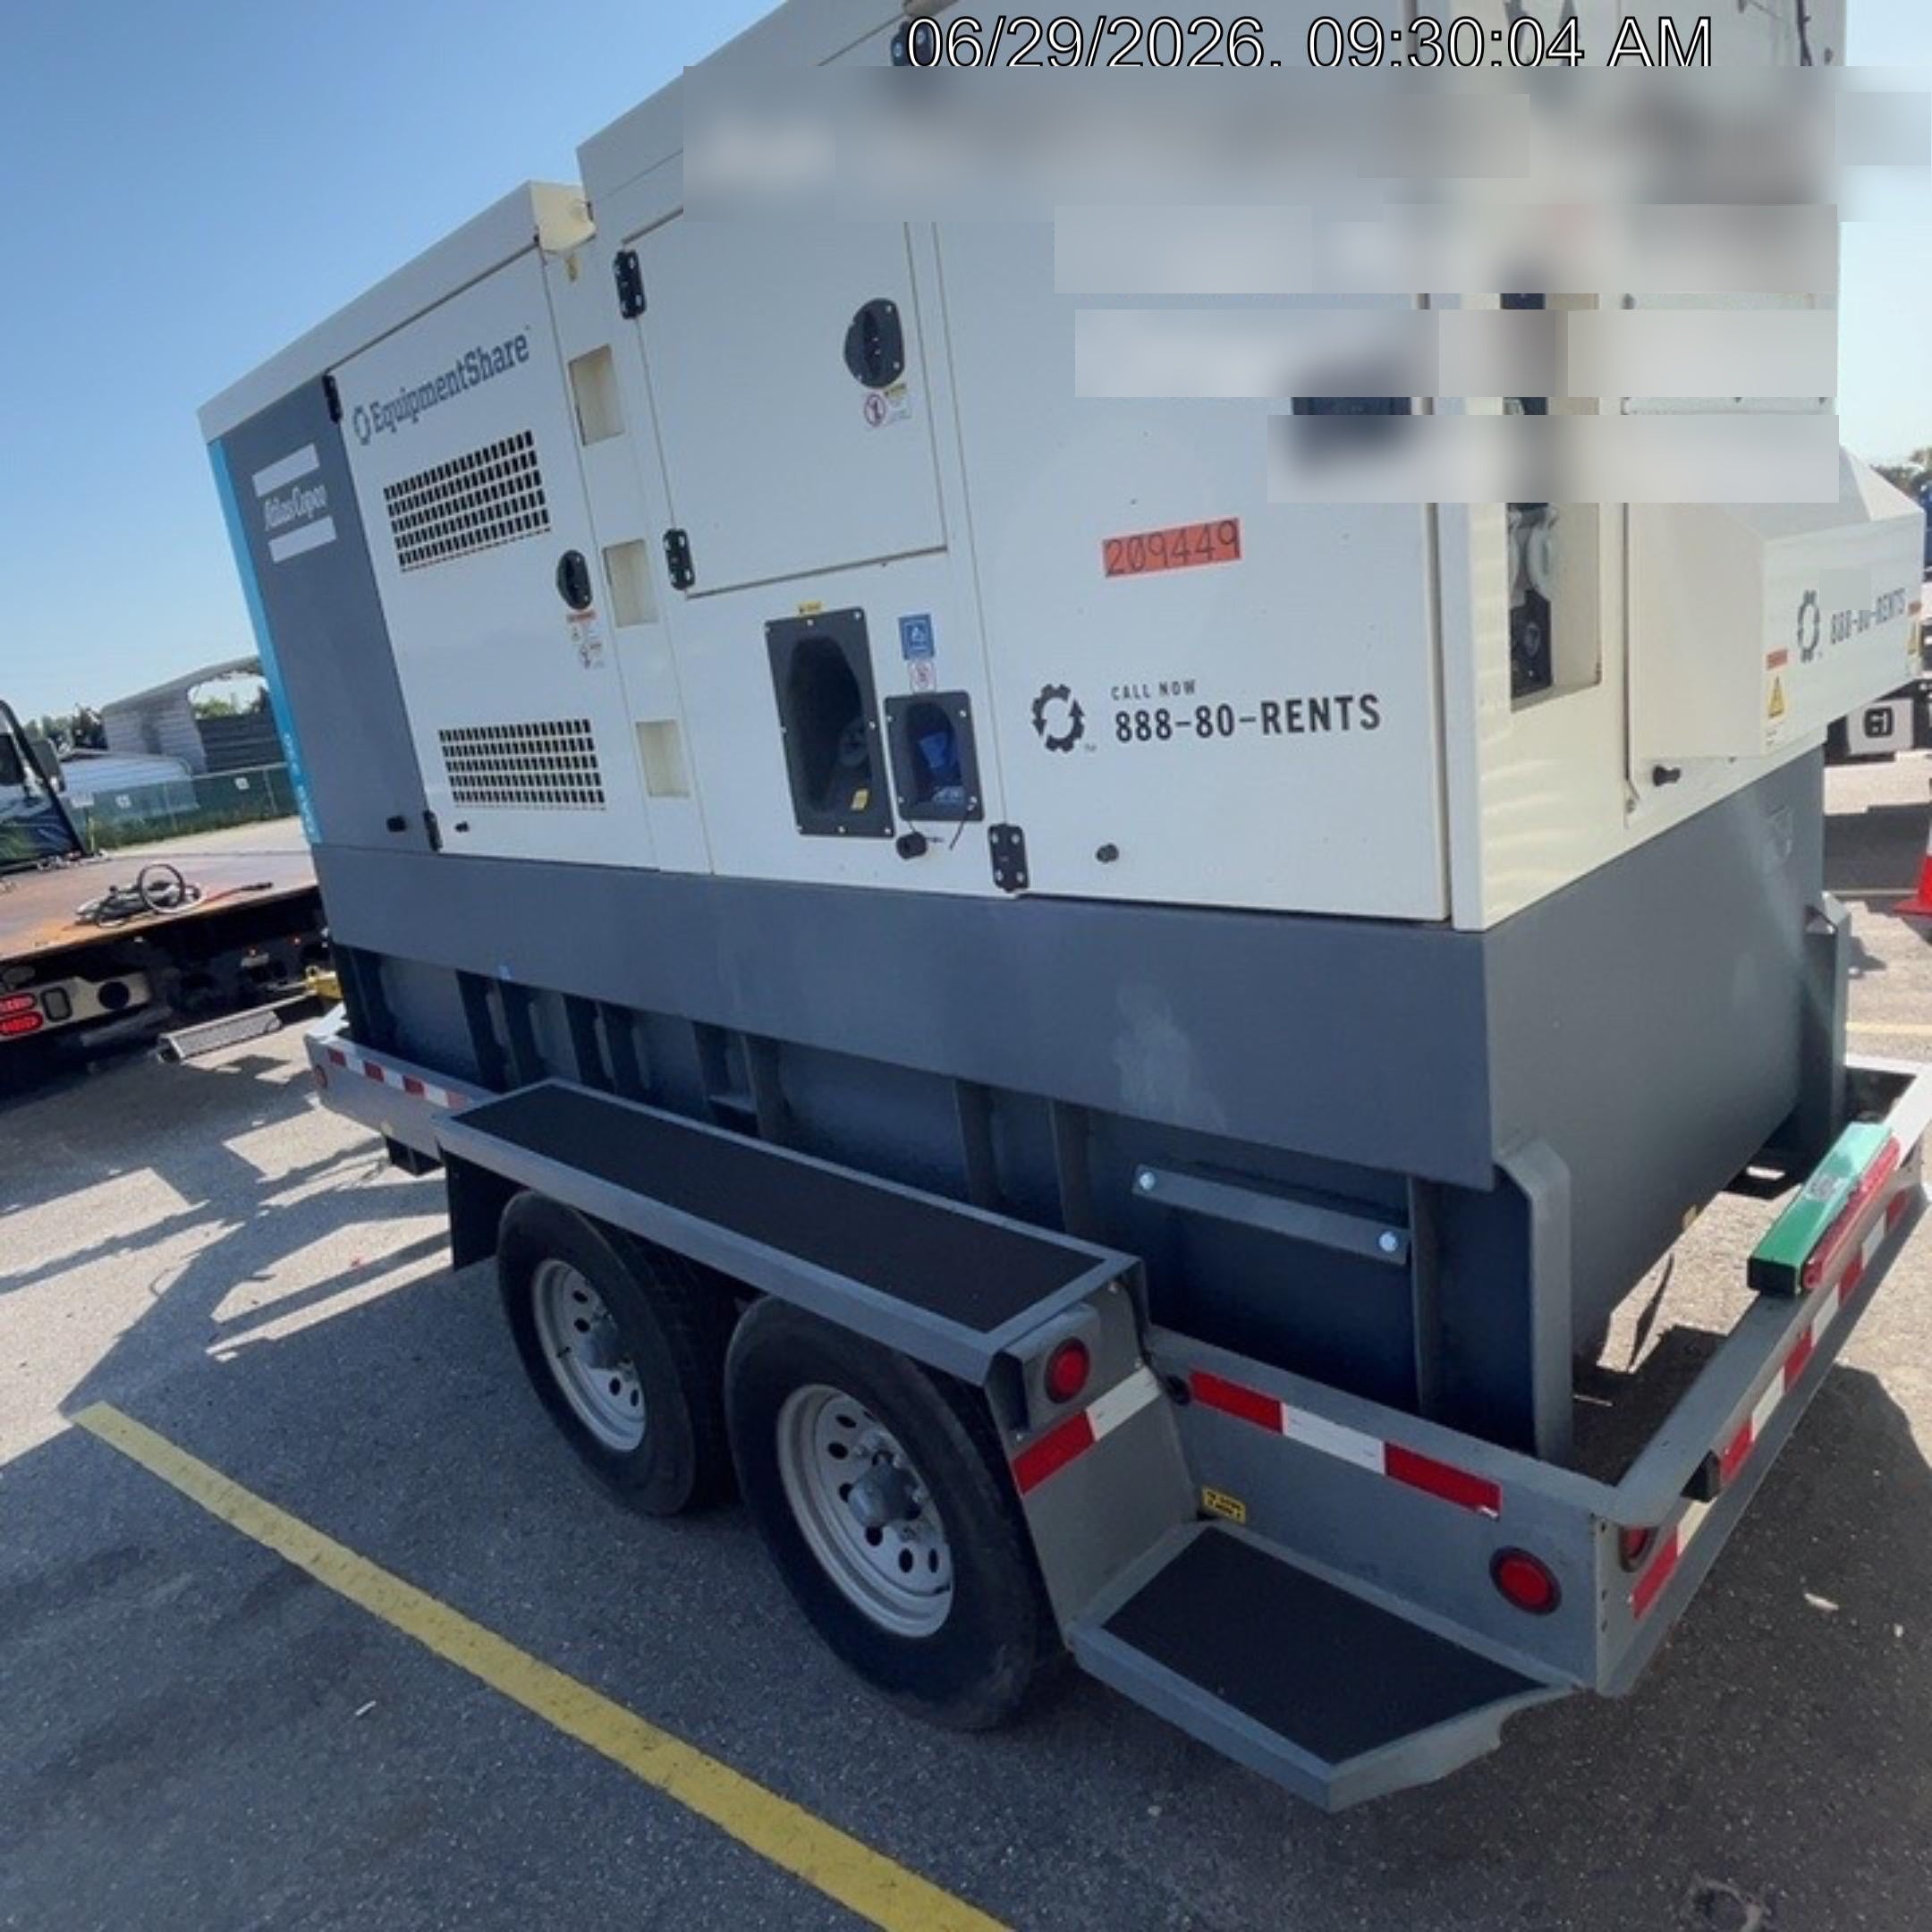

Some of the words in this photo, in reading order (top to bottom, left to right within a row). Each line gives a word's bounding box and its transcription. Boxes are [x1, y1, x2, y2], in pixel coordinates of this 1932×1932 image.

[369, 335, 530, 433] EquipmentShare
[1106, 520, 1240, 575] 209449
[1111, 683, 1150, 701] CALL
[1159, 679, 1196, 697] NOW
[1115, 693, 1381, 743] 888-80-RENTS
